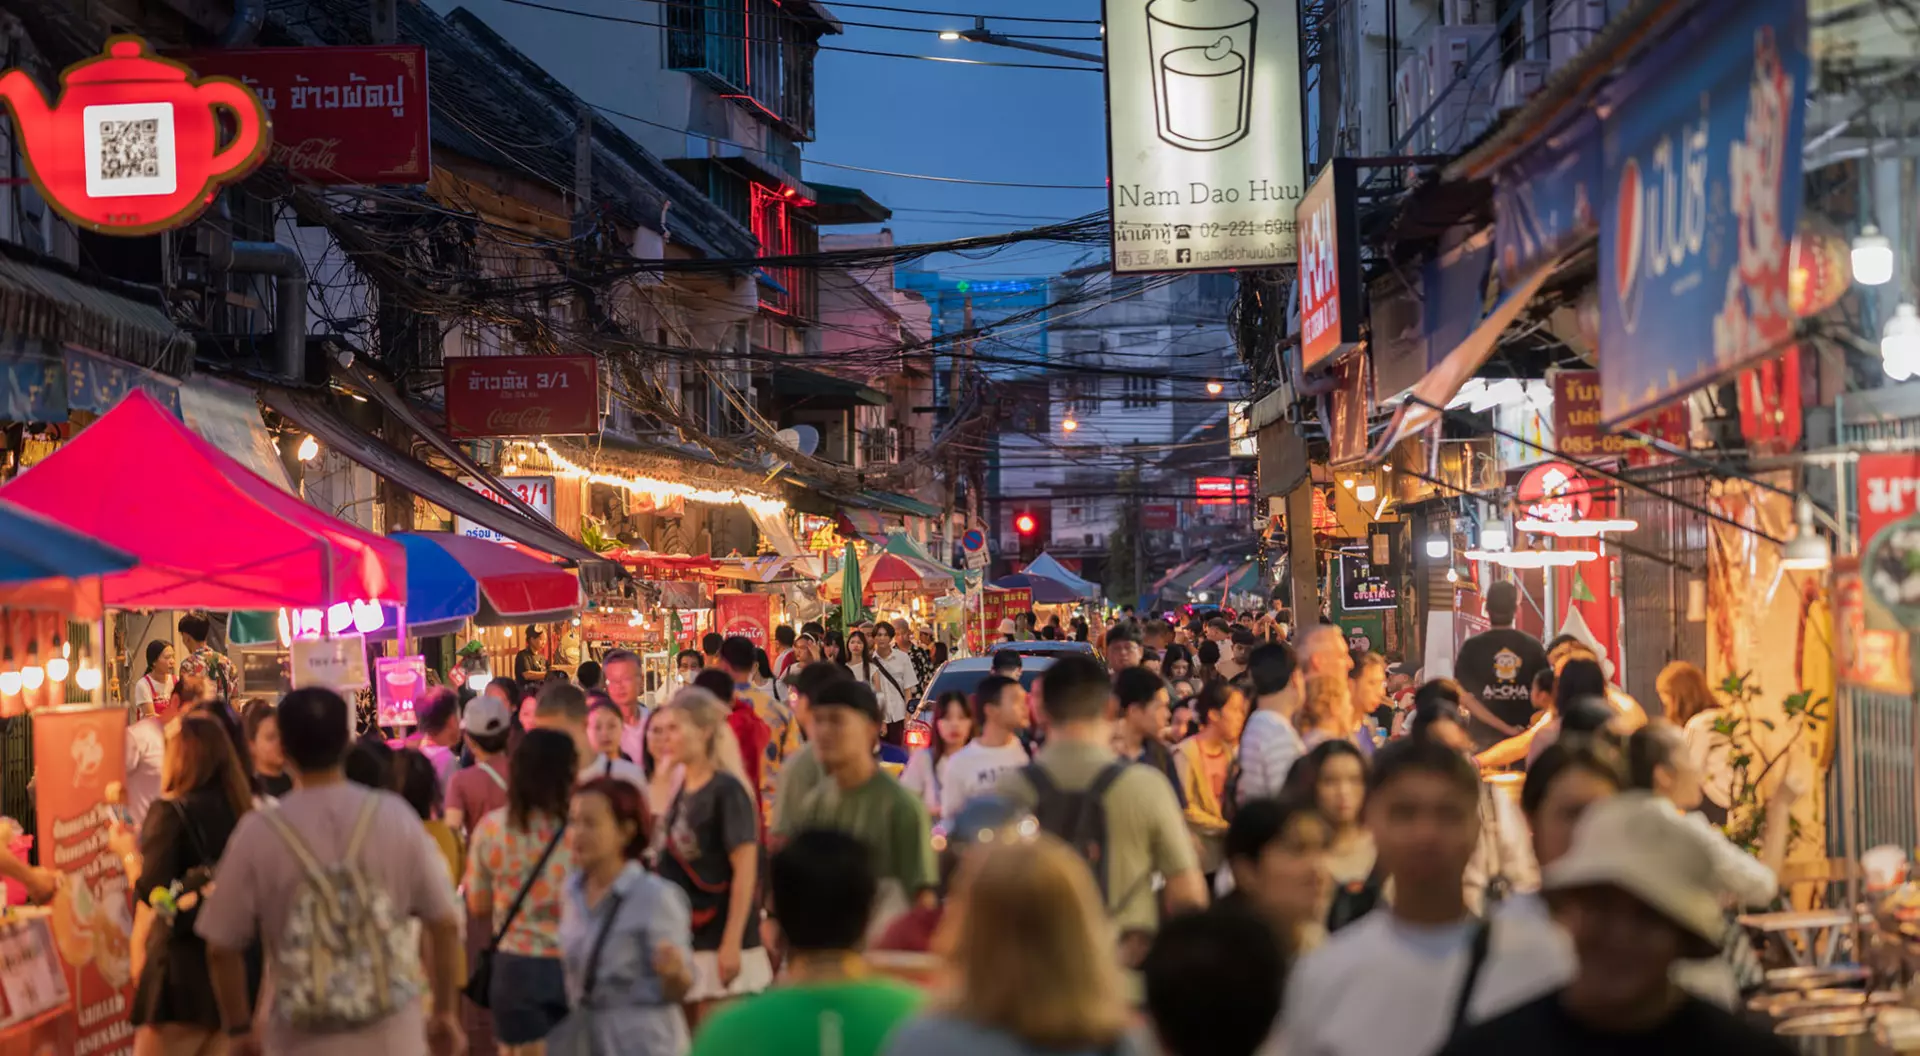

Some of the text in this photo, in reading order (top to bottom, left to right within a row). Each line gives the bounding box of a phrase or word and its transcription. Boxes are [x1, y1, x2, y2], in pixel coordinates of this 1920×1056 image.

[290, 72, 404, 117] ข้าวผัดปู
[1118, 179, 1299, 207] Nam Dao Huu
[468, 370, 569, 390] ข้าวต้ม 3/1
[517, 483, 547, 505] 3/1
